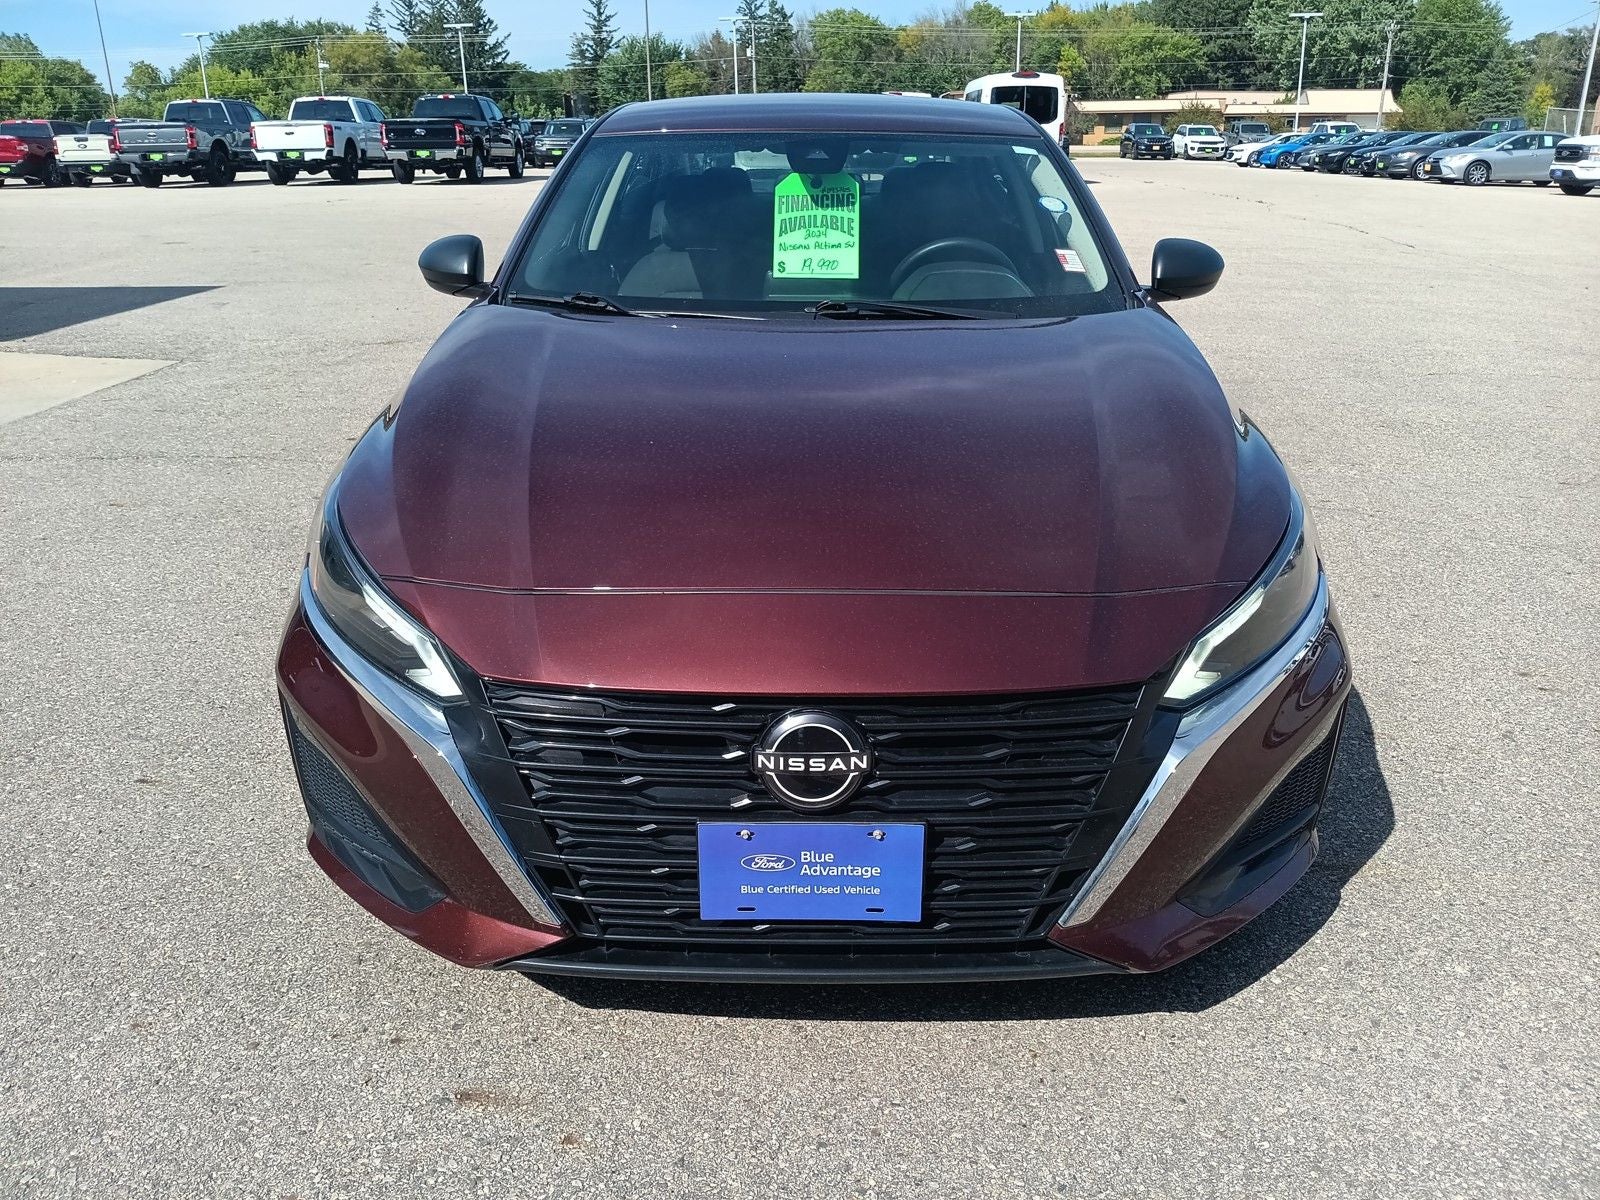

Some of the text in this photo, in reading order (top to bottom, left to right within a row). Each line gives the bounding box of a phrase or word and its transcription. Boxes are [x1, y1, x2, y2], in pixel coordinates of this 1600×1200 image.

[777, 192, 856, 214] FINANCING
[778, 214, 855, 238] AVAILABLE
[804, 229, 828, 240] 2024
[777, 257, 839, 274] $ 19,990
[757, 754, 867, 771] NISSAN
[751, 856, 786, 869] Ford
[800, 851, 835, 862] Blue
[800, 864, 881, 878] Advantage
[740, 885, 881, 895] Blue Certified Used Vehicle
